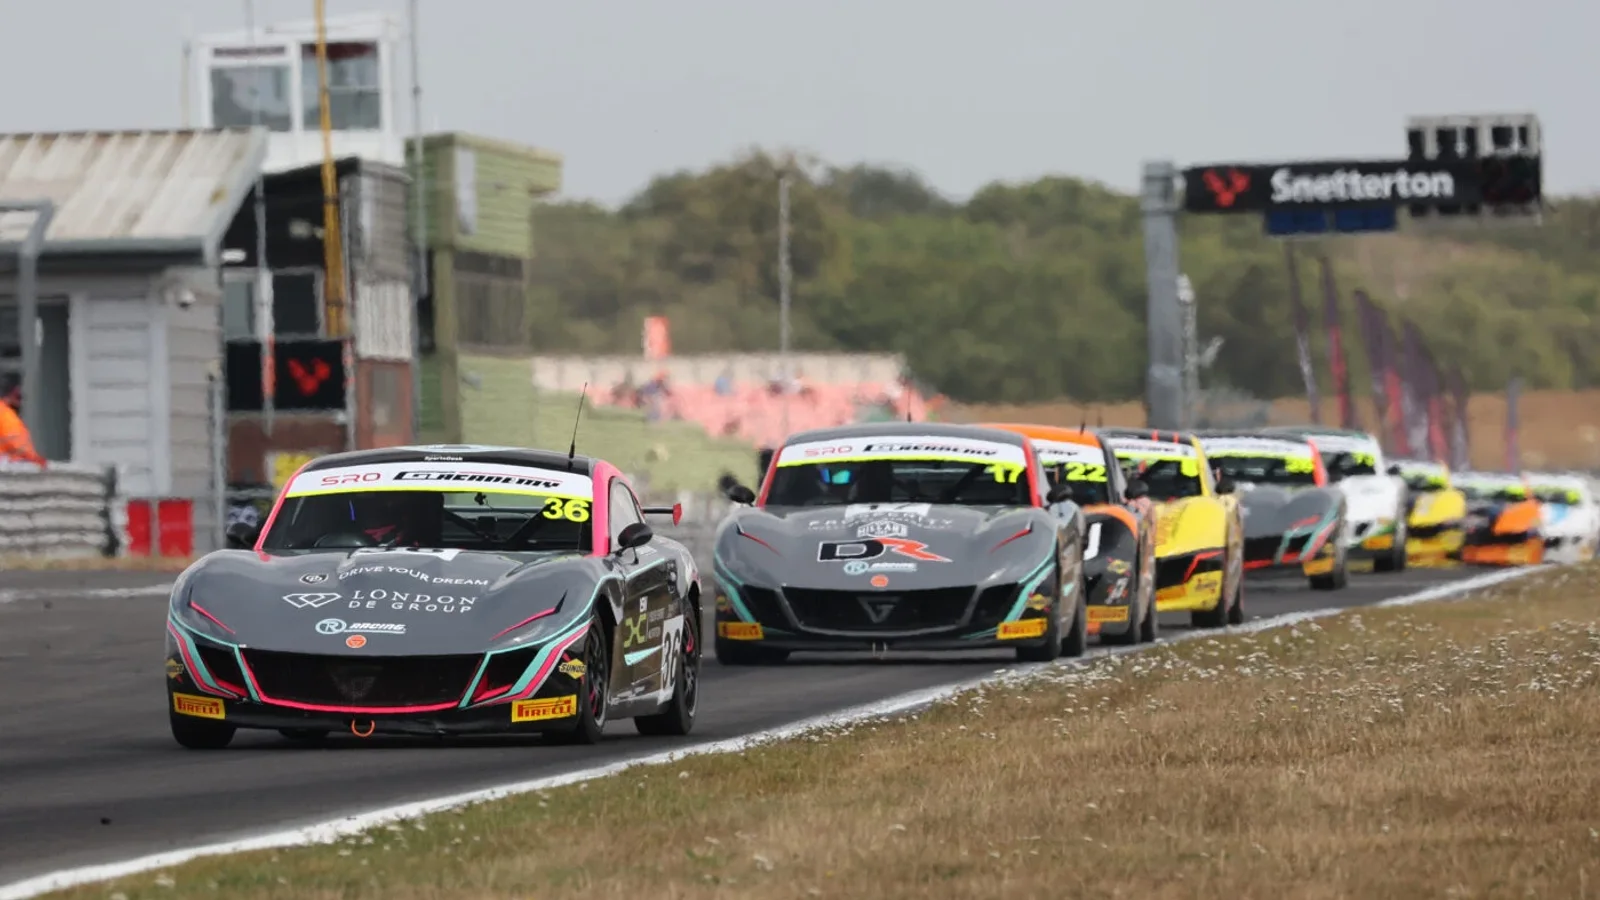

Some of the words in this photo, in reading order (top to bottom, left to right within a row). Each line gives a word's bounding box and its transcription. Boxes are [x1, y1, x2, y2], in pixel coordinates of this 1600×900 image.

[1269, 167, 1454, 203] Snetterton
[804, 445, 852, 457] SRO
[320, 472, 381, 486] SRO
[984, 463, 1023, 483] 17
[1064, 462, 1108, 483] 22
[542, 497, 590, 522] 36
[338, 565, 385, 580] DRIVE
[387, 565, 429, 582] YOUR
[432, 577, 489, 586] DREAM
[352, 588, 478, 605] LONDON
[348, 600, 376, 609] DE
[391, 602, 472, 613] GROUP
[176, 696, 220, 715] PIRELLI
[517, 699, 572, 718] PIRELLI
